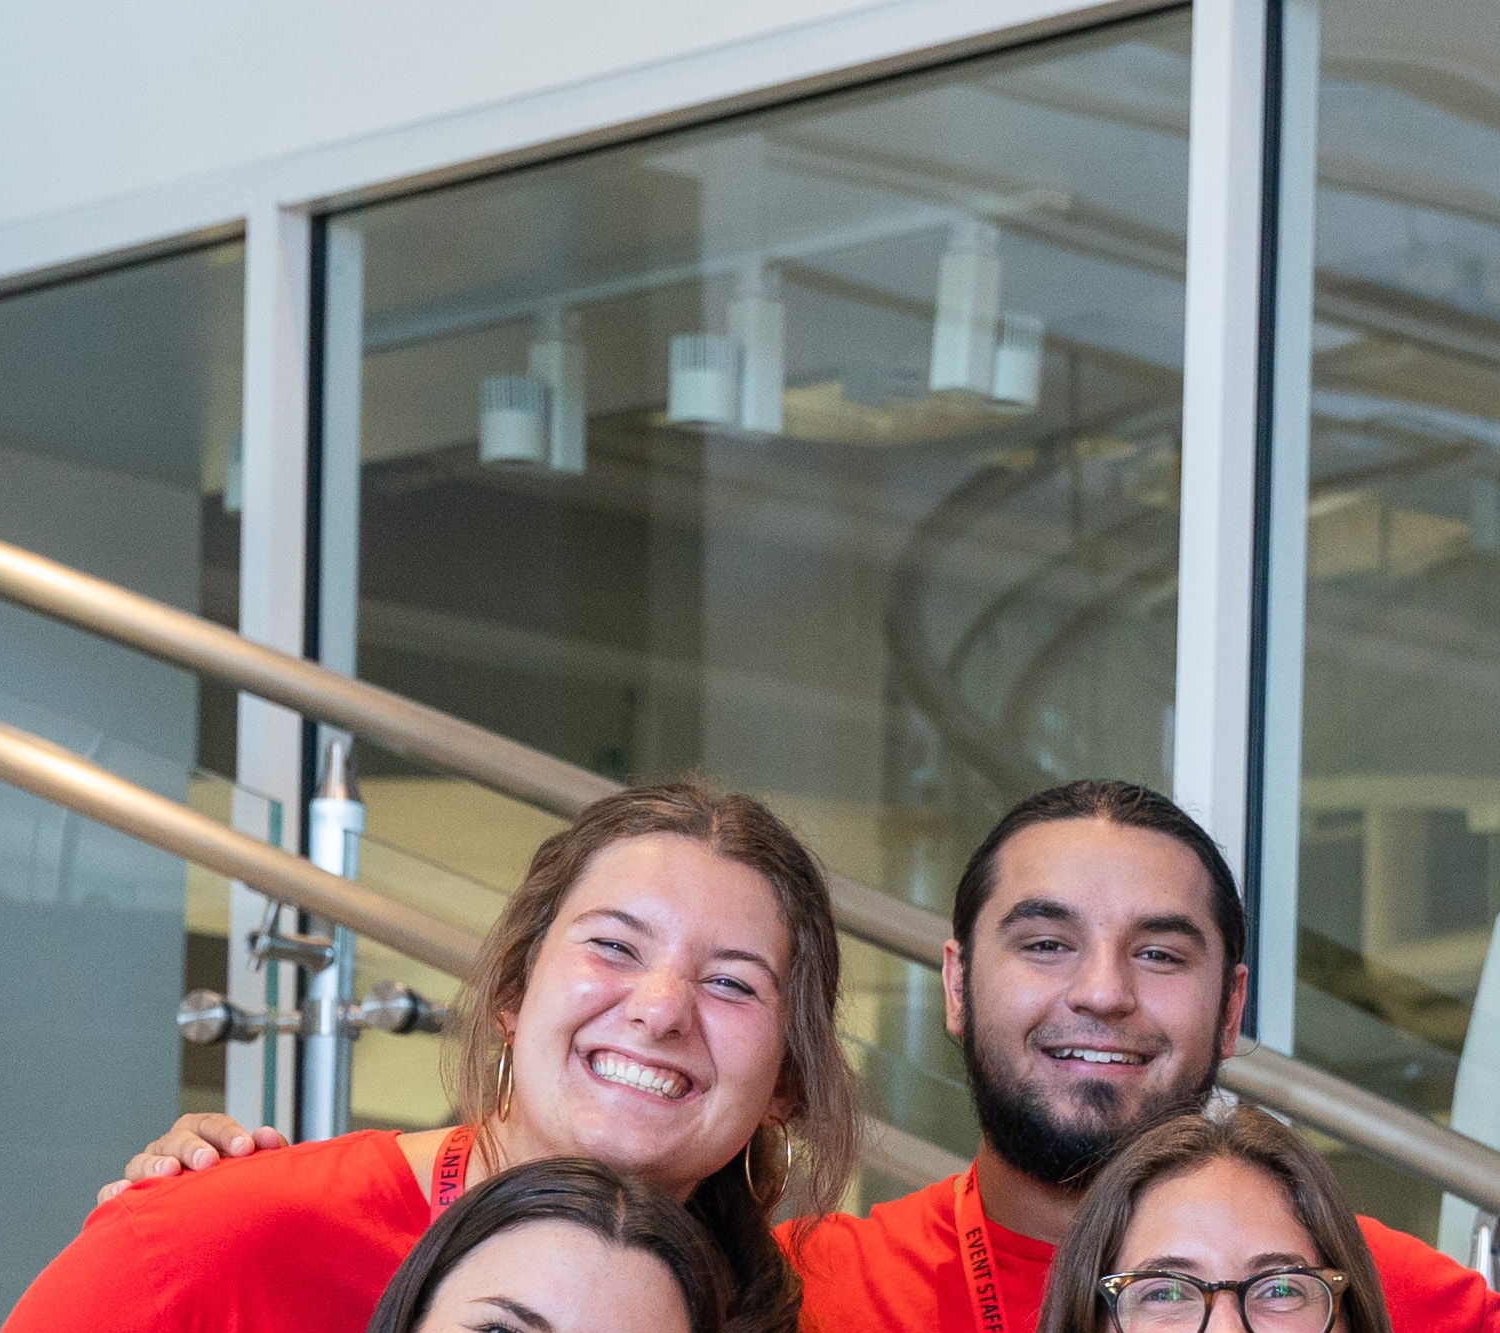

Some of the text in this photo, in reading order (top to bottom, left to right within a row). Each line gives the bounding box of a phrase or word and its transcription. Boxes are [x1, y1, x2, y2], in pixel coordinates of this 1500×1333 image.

[440, 1147, 463, 1206] EVENT
[965, 1227, 1004, 1333] EVENT STAFF
